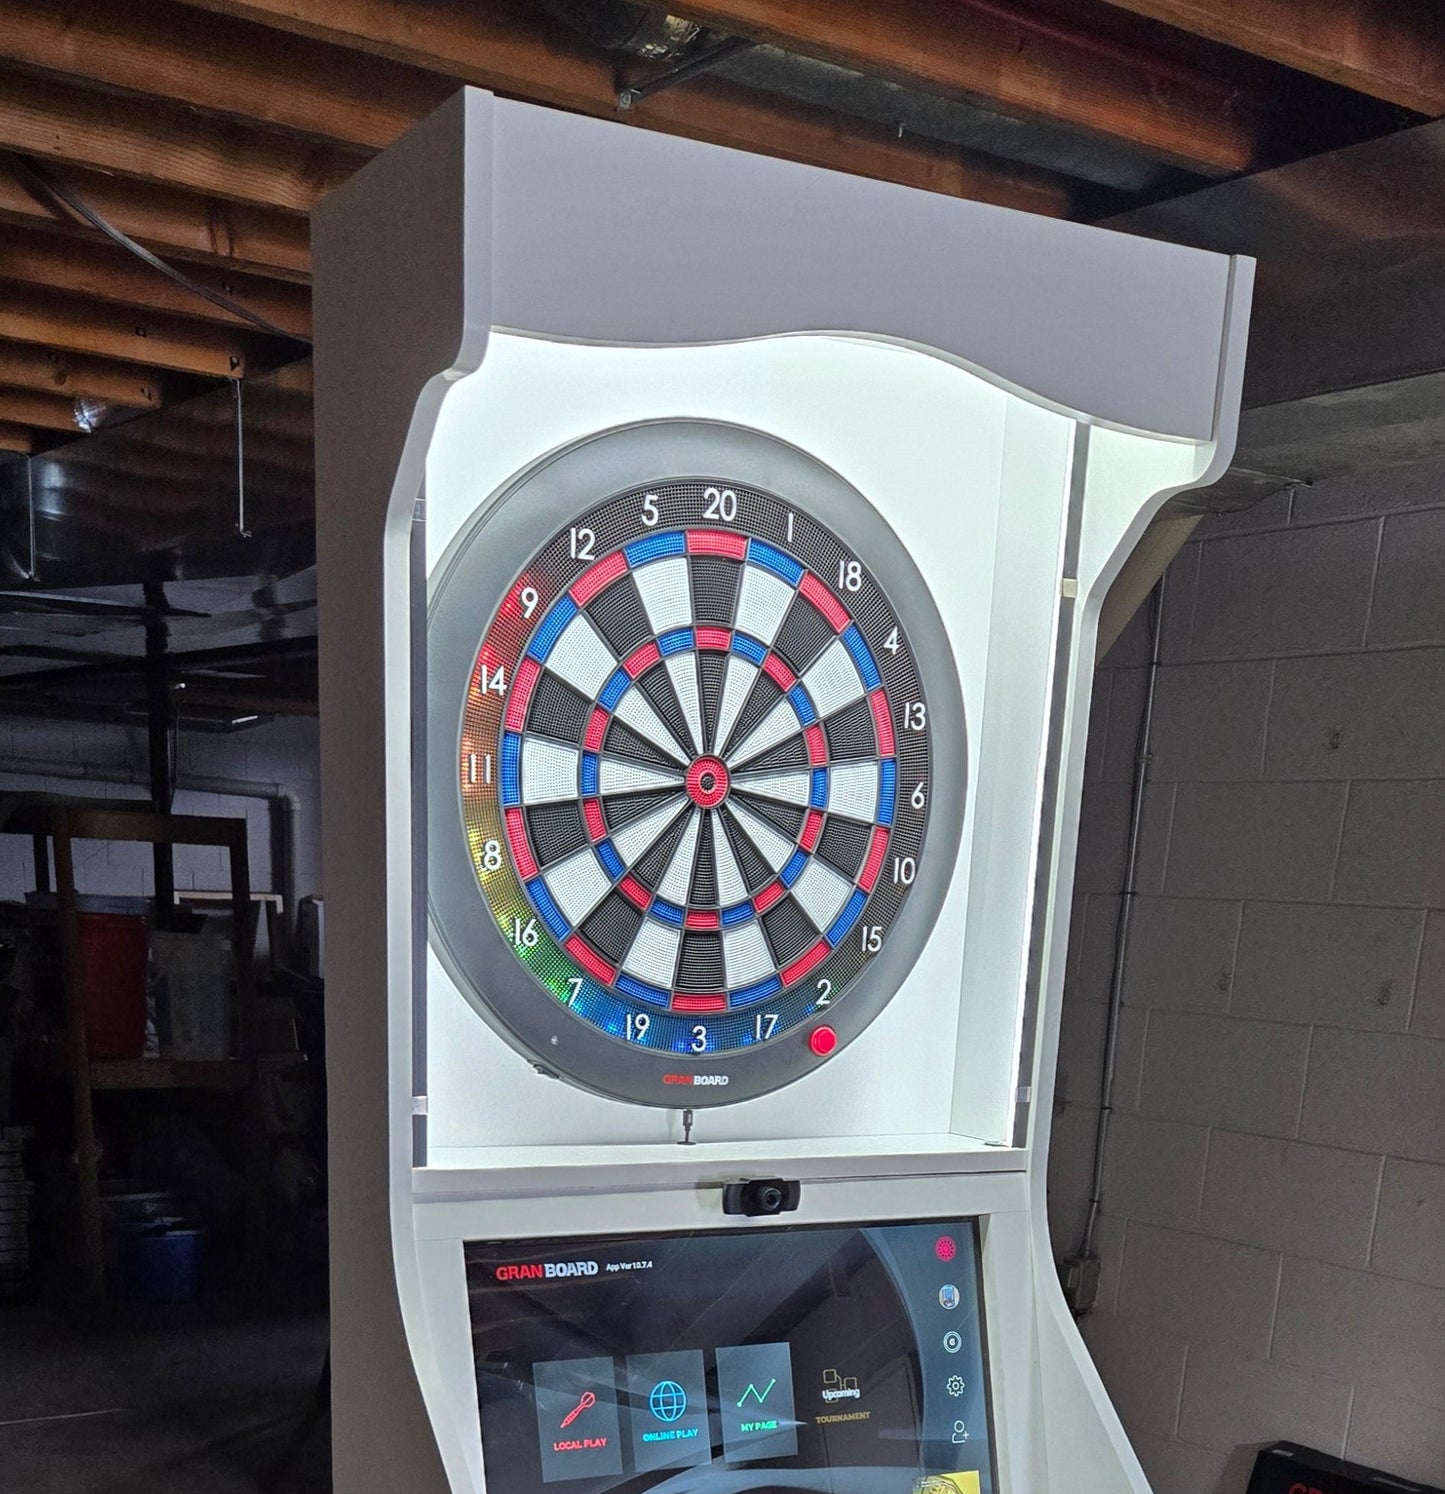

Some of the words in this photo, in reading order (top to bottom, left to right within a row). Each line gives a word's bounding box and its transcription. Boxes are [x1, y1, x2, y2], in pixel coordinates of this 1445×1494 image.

[643, 495, 658, 525] 5
[703, 488, 737, 521] 20
[786, 512, 794, 541] 1
[570, 528, 595, 560] 12
[839, 561, 862, 591] 18
[521, 588, 538, 618] 9
[883, 626, 900, 654] 4
[481, 665, 507, 694] 14
[904, 702, 926, 730] 13
[469, 753, 491, 783] 11
[911, 782, 925, 809] 6
[484, 841, 501, 870] 8
[893, 857, 916, 885] 10
[514, 918, 538, 947] 16
[862, 926, 882, 953] 15
[567, 978, 583, 1005] 7
[817, 978, 832, 1005] 2
[626, 1014, 649, 1042] 19
[692, 1026, 706, 1053] 3
[755, 1014, 778, 1041] 17
[822, 1388, 861, 1401] Upcoming
[741, 1422, 754, 1432] MY
[755, 1420, 778, 1431] PAGE
[815, 1411, 871, 1424] TOURNAMENT
[553, 1440, 583, 1451] LOCAL
[584, 1438, 607, 1449] PLAY
[643, 1430, 675, 1442] ONLINE
[676, 1428, 699, 1439] PLAY
